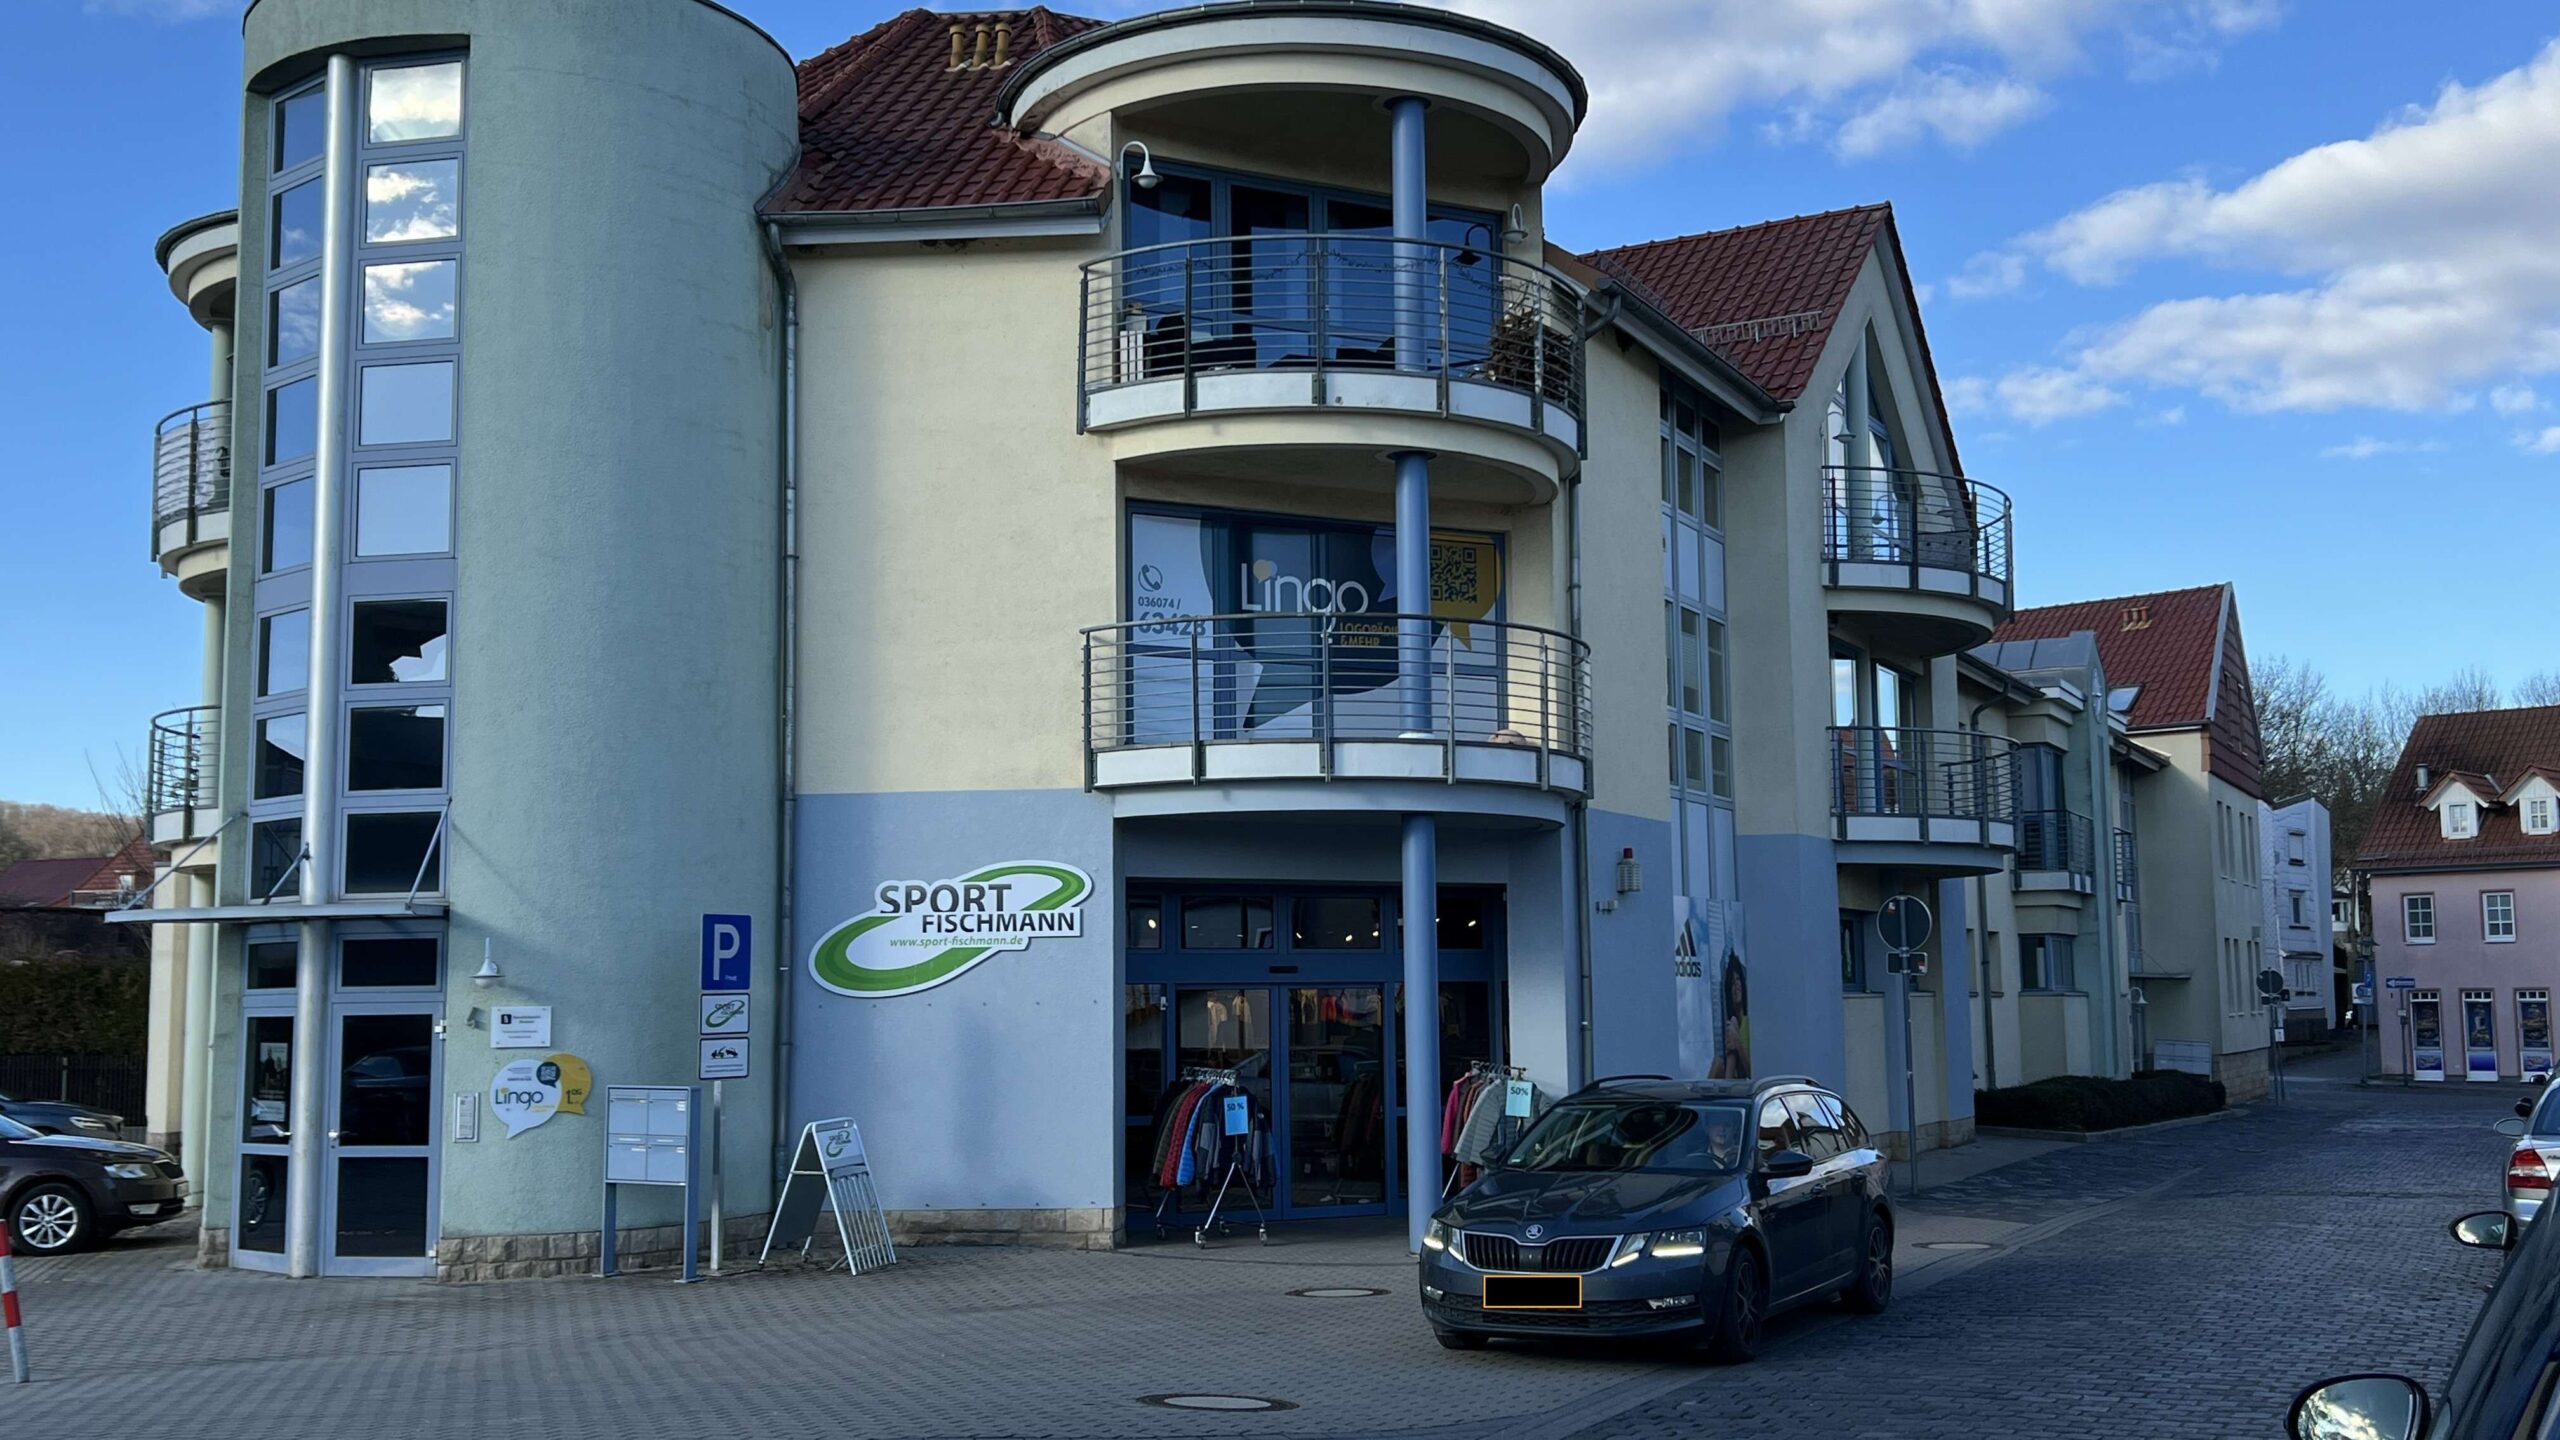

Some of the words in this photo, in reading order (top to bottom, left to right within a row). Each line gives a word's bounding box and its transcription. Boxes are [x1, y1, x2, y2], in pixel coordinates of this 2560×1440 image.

[1138, 596, 1175, 609] 036074
[1241, 562, 1369, 644] Lingo
[880, 883, 1012, 914] SPORT
[922, 912, 1075, 934] FISCHMANN
[713, 923, 741, 981] P
[889, 935, 1024, 948] www.sport-fischmann.de
[495, 1087, 544, 1110] Lingo
[1510, 1086, 1529, 1096] 50%
